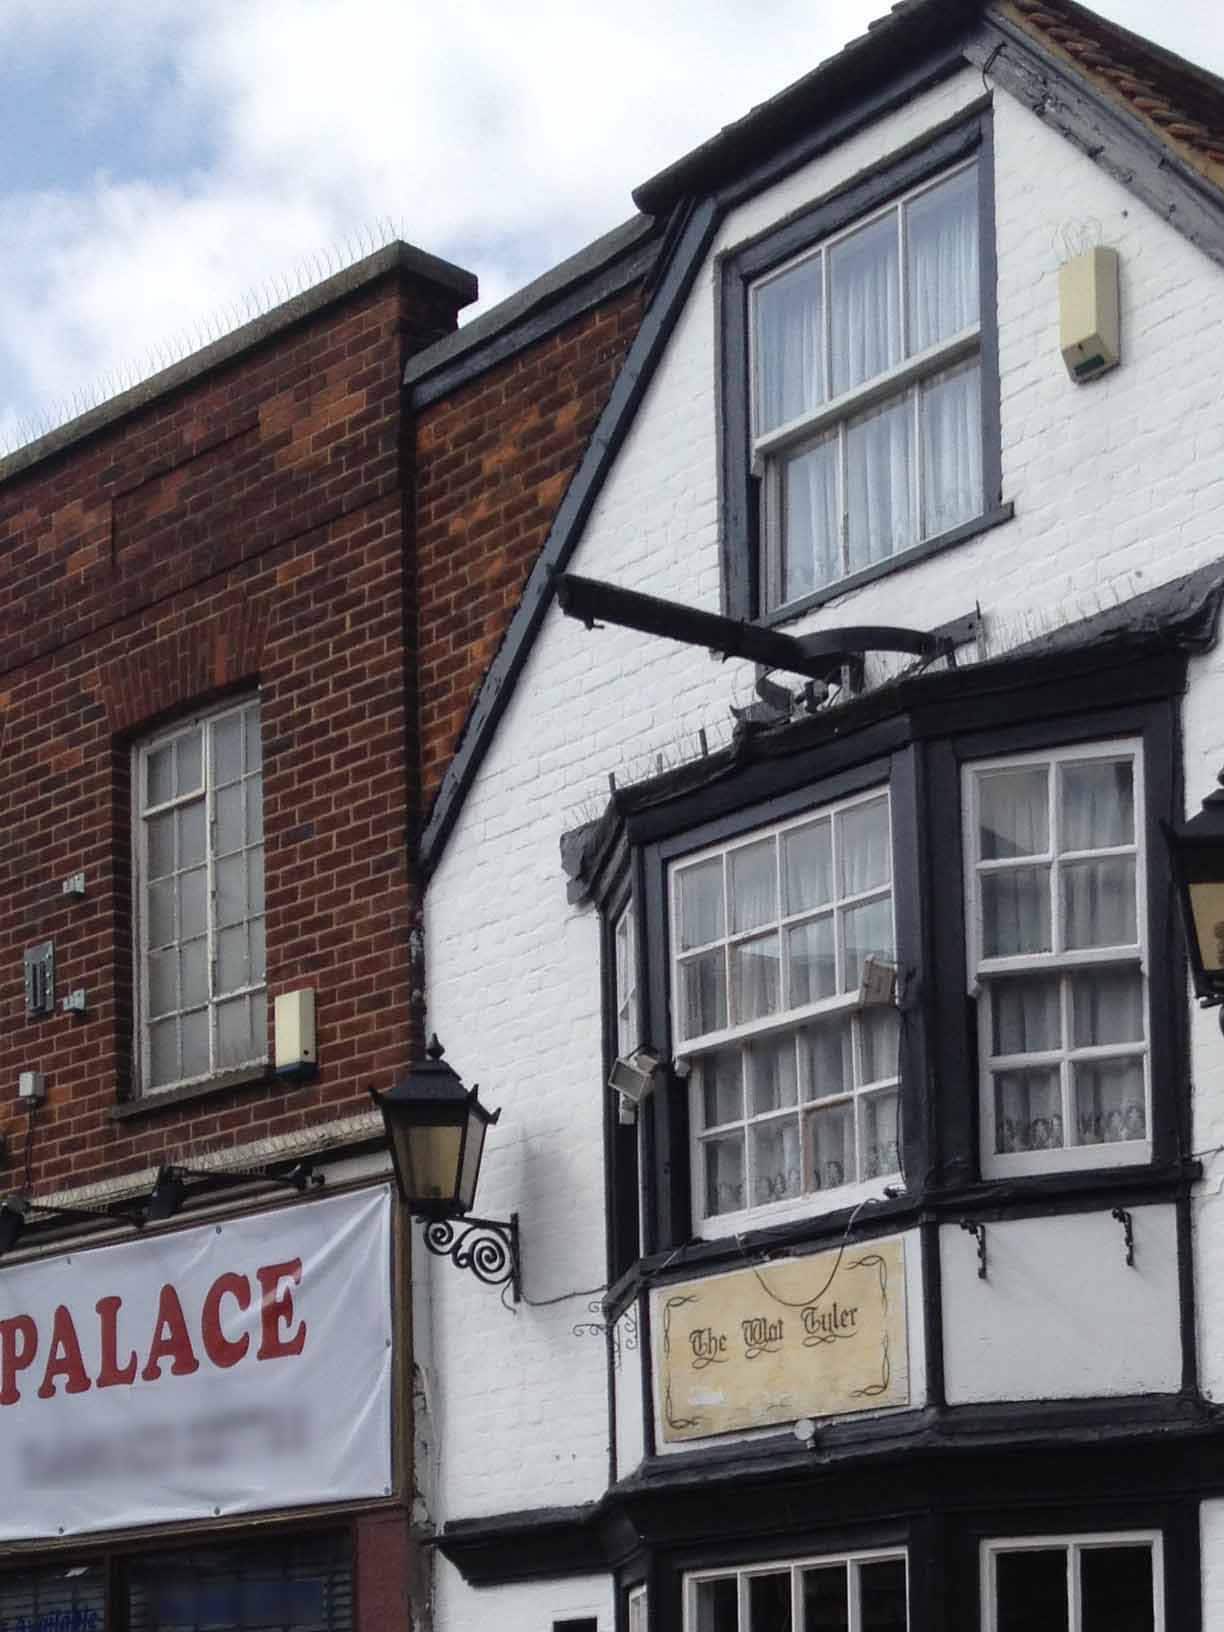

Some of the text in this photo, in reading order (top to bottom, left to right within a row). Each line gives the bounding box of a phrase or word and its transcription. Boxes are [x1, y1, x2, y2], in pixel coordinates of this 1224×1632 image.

[0, 1257, 307, 1405] PALACE
[689, 1301, 858, 1363] The Wat Tyler
